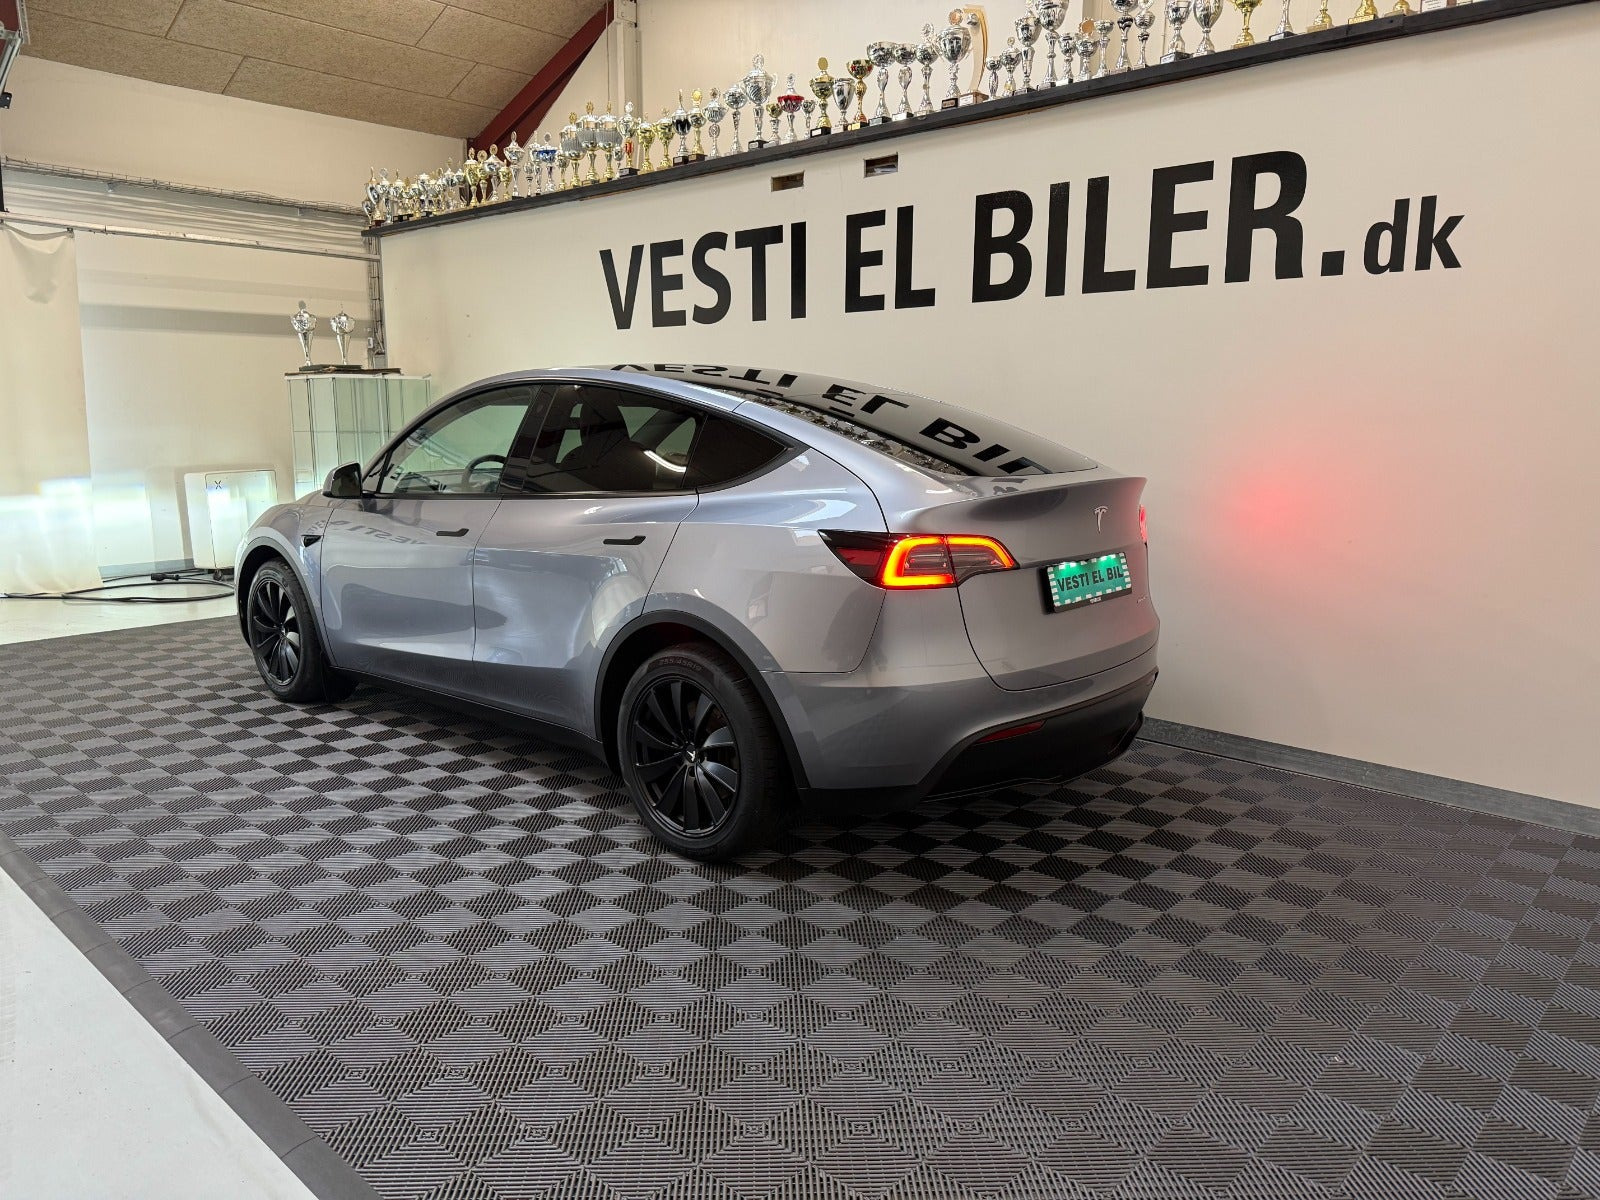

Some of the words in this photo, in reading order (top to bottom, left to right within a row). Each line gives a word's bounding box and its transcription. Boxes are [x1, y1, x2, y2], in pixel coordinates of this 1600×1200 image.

[600, 222, 807, 330] VESTI
[845, 205, 935, 313] EL
[1056, 572, 1090, 592] VESTI
[1091, 570, 1105, 585] EL
[1106, 565, 1124, 581] BIL
